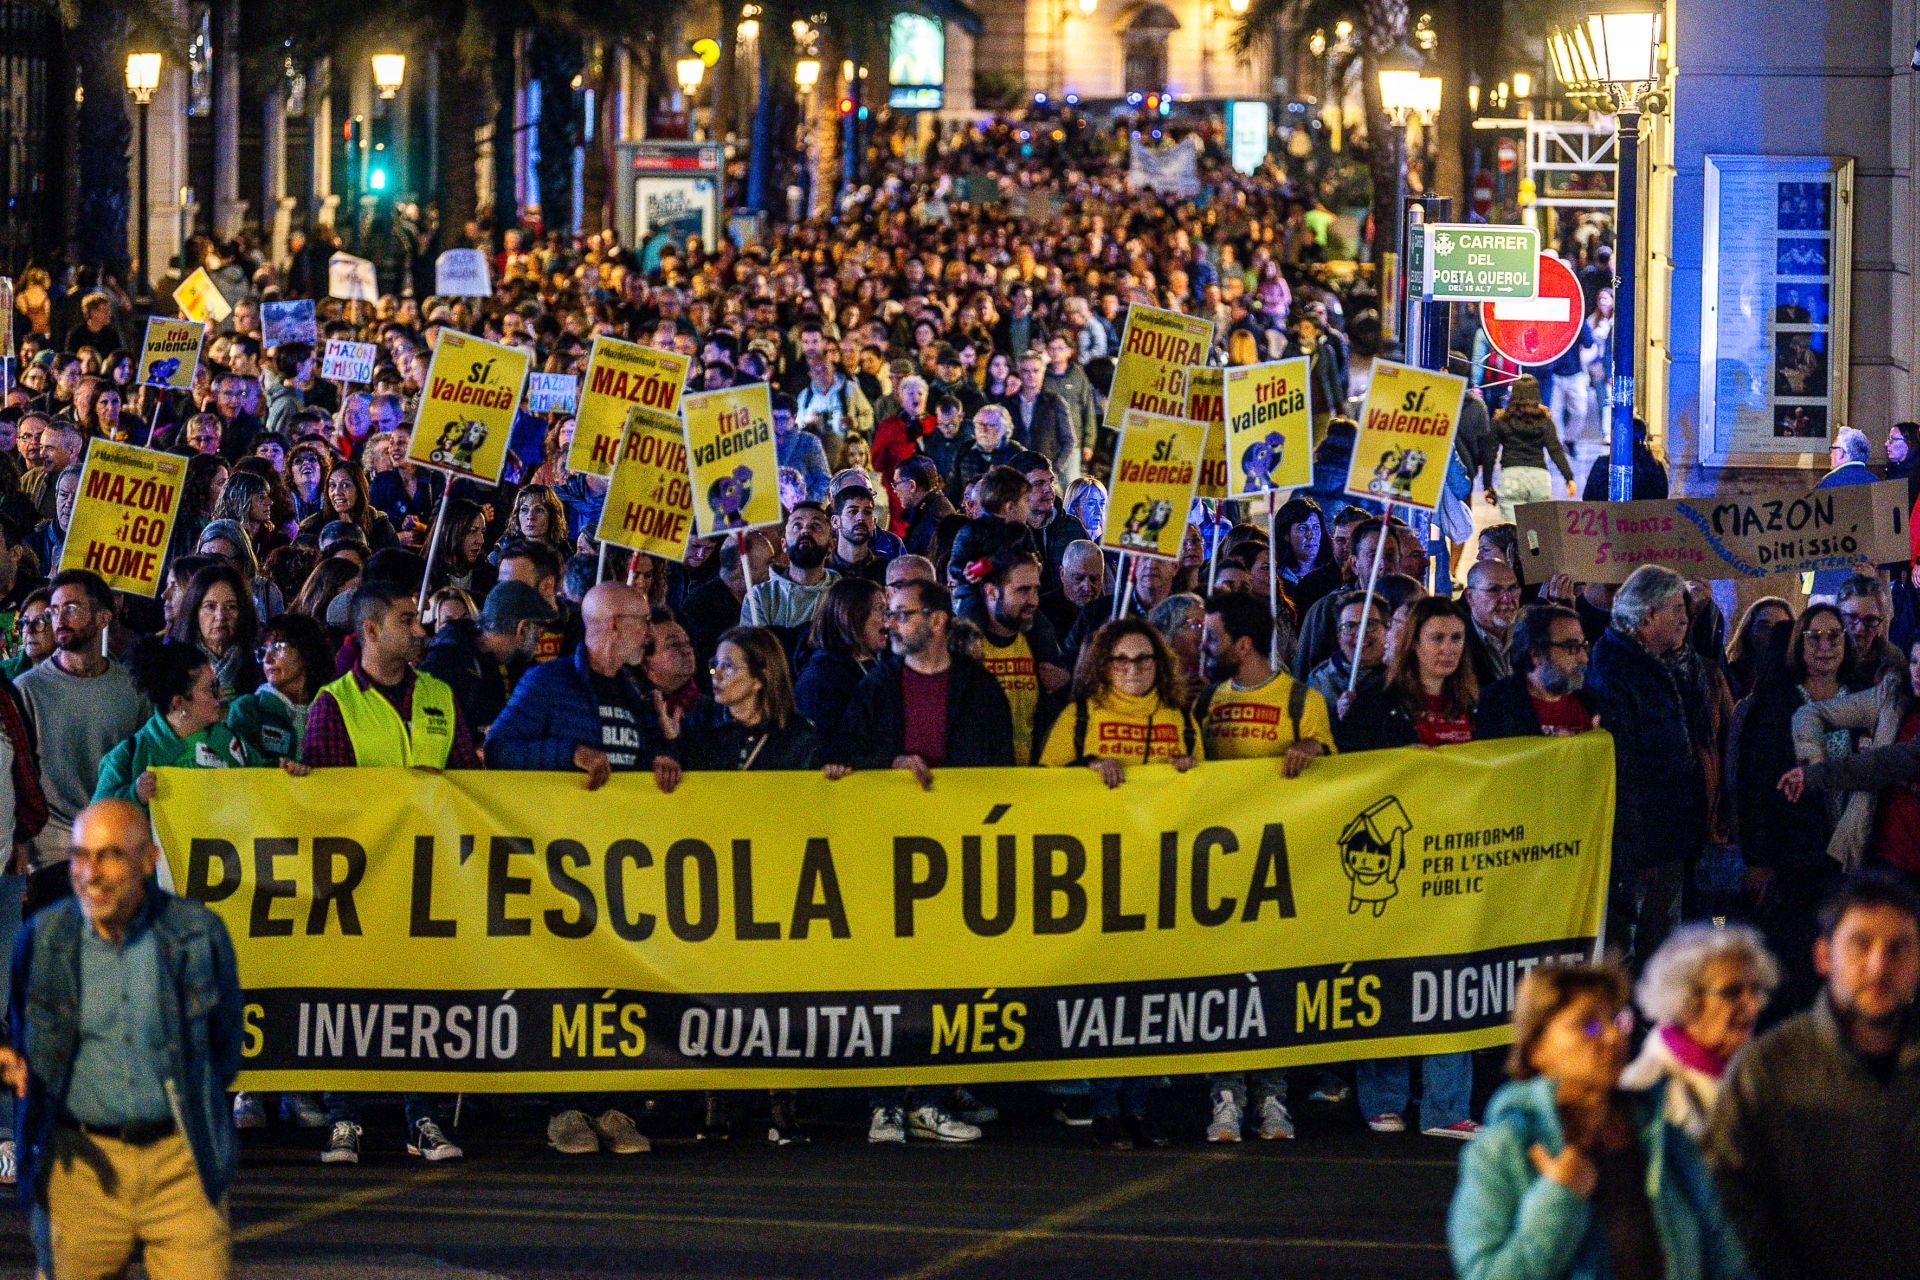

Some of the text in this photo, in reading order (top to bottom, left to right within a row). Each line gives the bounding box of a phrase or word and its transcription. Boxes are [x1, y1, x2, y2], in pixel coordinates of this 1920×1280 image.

[1460, 235, 1528, 250] CARRER
[1468, 254, 1495, 265] DEL
[1433, 270, 1530, 285] POETA QUEROL
[147, 338, 198, 352] valencià
[168, 329, 189, 341] tria
[1127, 326, 1201, 366] ROVIRA
[431, 376, 513, 411] Valencià
[591, 366, 677, 409] MAZÓN
[1256, 376, 1287, 404] tria
[718, 406, 750, 435] tria
[1232, 388, 1304, 433] valencià
[1367, 408, 1450, 436] Valencià
[624, 431, 688, 475] ROVIR
[694, 417, 769, 467] valencià
[1119, 459, 1193, 485] Valencià
[86, 469, 174, 515] MAZÓN
[623, 501, 687, 544] HOME
[1566, 508, 1609, 537] 221
[1711, 492, 1834, 536] MAZÓN
[84, 540, 158, 582] HOME
[1423, 825, 1525, 852] PLATAFORMA
[185, 804, 1297, 942] PER L'ESCOLA PÚBLICA
[1423, 839, 1582, 875] PER L'ENSENYAMENT
[1422, 875, 1483, 898] PÚBLIC
[298, 989, 518, 1059] INVERSIÓ
[552, 989, 647, 1058] MÉS
[678, 1006, 900, 1058] QUALITAT
[930, 988, 1028, 1055] MÉS
[1056, 973, 1267, 1048] VALENCIÀ
[1296, 962, 1381, 1034] MÉS
